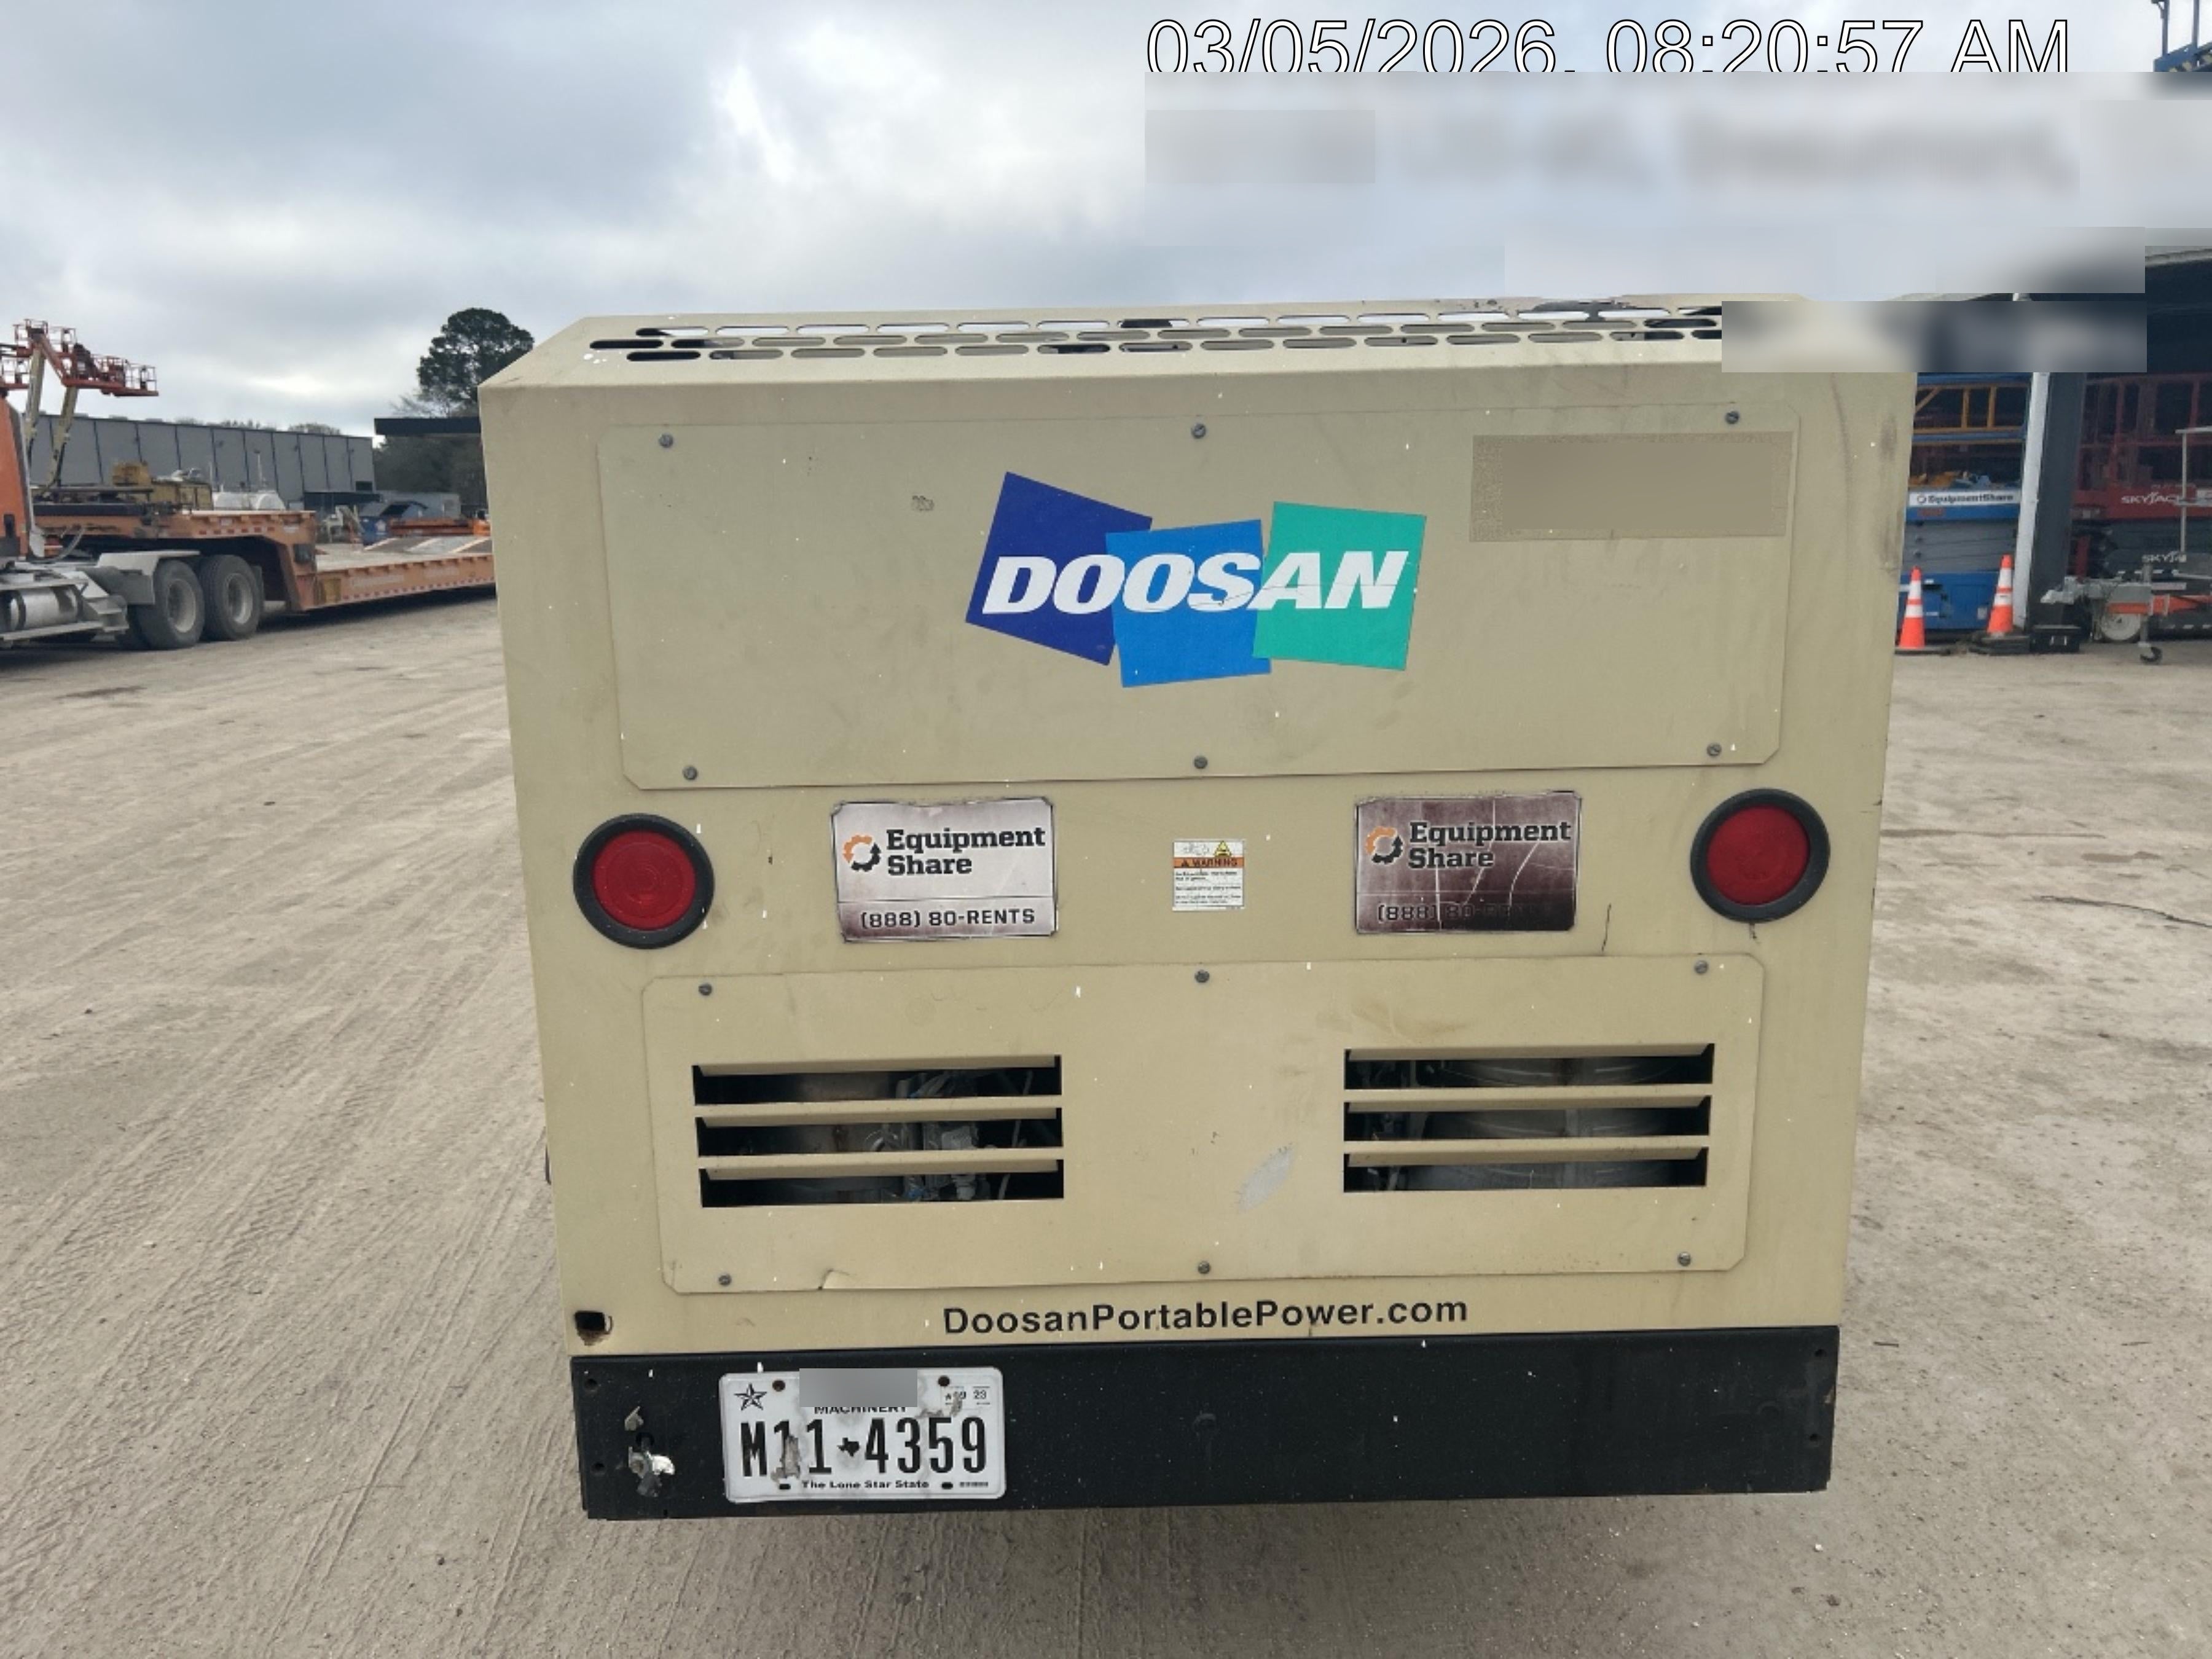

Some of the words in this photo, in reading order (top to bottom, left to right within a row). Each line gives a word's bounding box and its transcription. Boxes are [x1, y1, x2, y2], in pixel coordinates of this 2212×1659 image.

[982, 550, 1410, 615] DOOSAN
[886, 827, 1046, 854] Equipment
[1409, 821, 1571, 847] Equipment
[887, 855, 972, 876] Share
[1408, 847, 1494, 869] Share
[861, 910, 920, 930] (888)
[928, 908, 1035, 927] 80-RENTS
[1378, 903, 1437, 924] (888)
[943, 1299, 1469, 1335] DoosanPortablePower.com
[865, 1416, 987, 1474] 4359
[802, 1480, 826, 1489] The
[830, 1480, 861, 1489] Lone
[864, 1480, 891, 1489] Star
[895, 1480, 930, 1489] State
